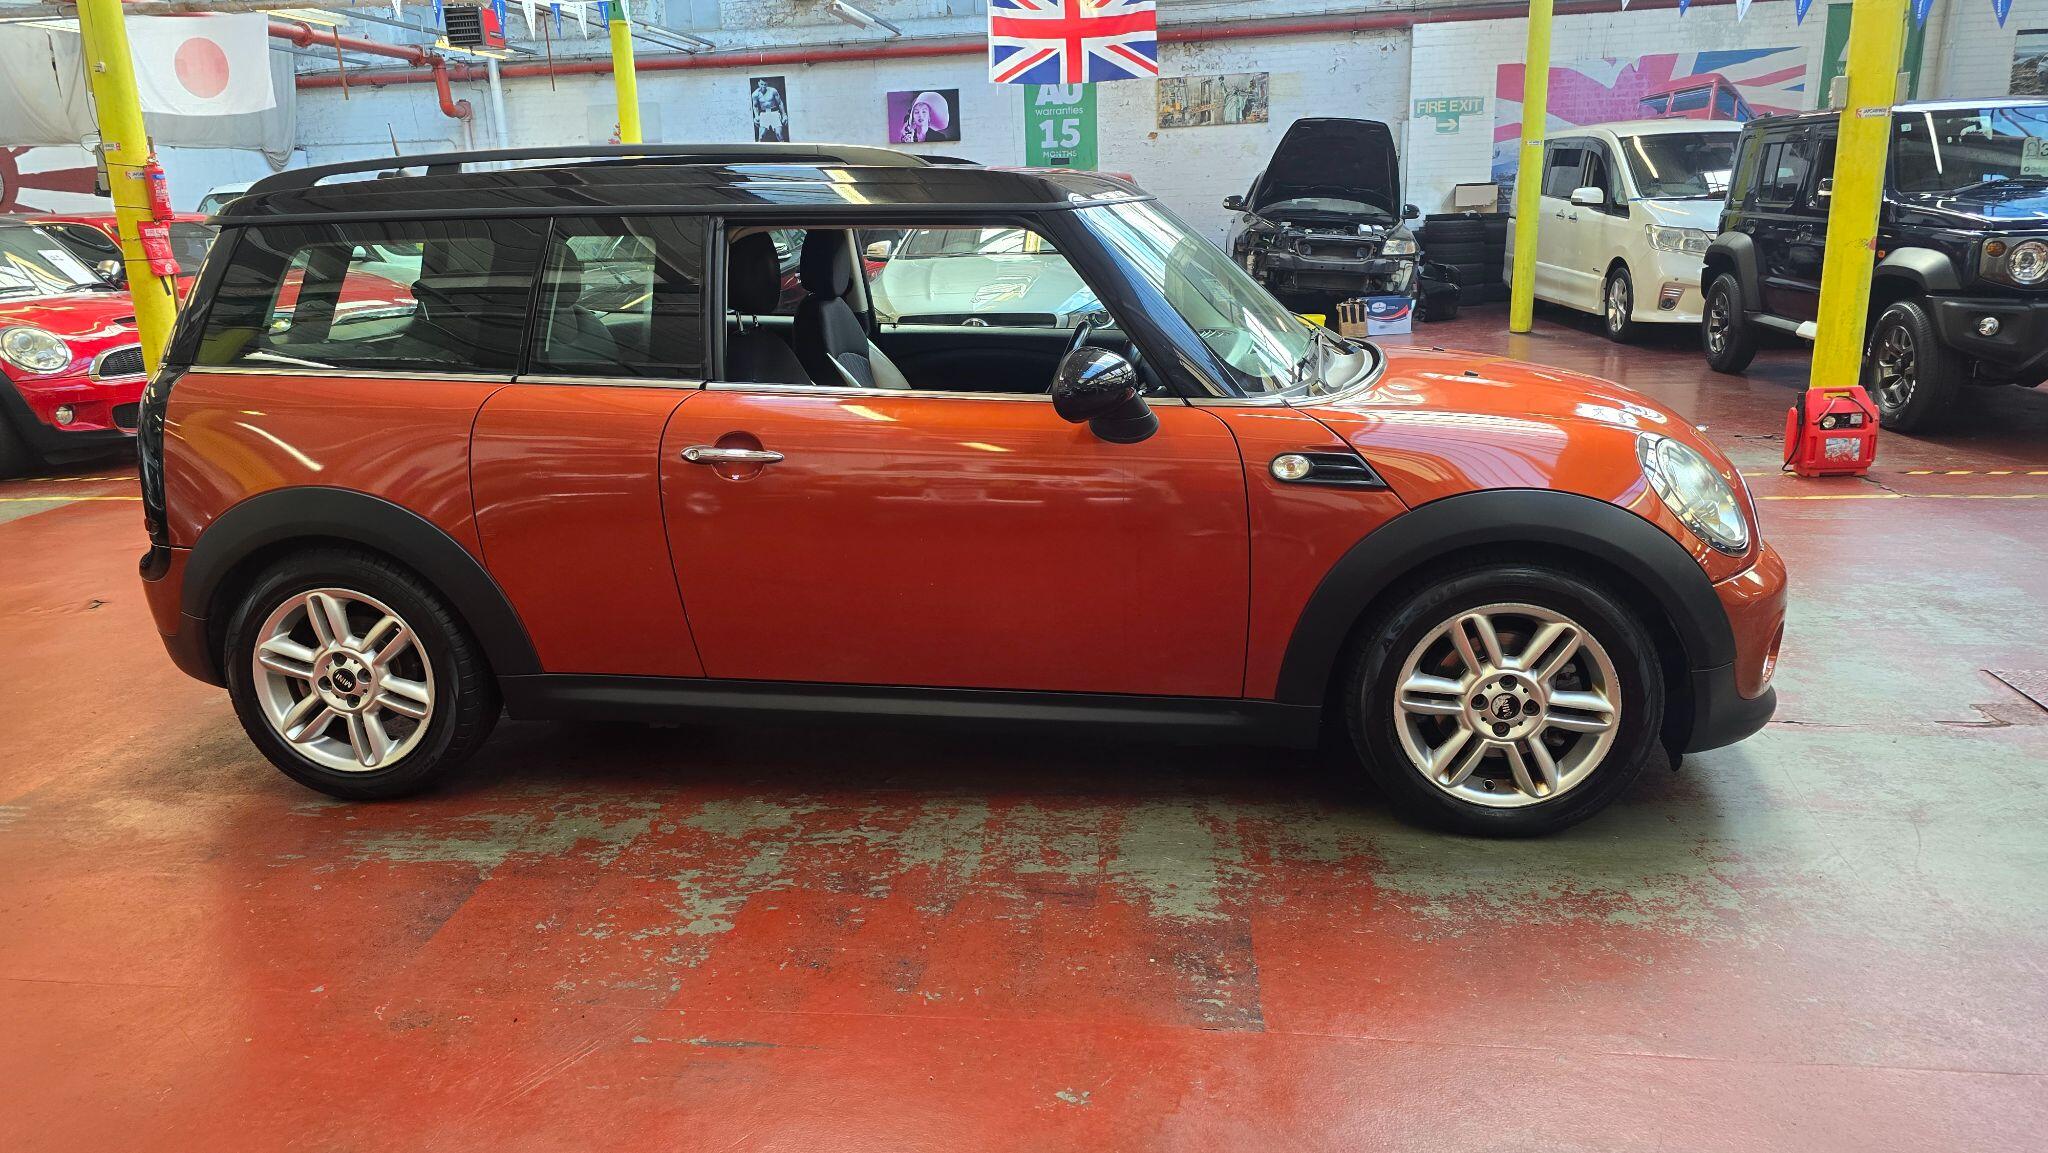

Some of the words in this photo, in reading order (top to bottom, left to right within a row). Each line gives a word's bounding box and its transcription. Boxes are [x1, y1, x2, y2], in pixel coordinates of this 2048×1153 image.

[1035, 83, 1083, 105] AU
[1035, 106, 1084, 116] warranties
[1417, 101, 1446, 113] FIRE
[1449, 99, 1482, 111] EXIT
[1039, 118, 1081, 149] 15
[1042, 150, 1078, 158] MONTHS
[335, 673, 353, 688] MINI
